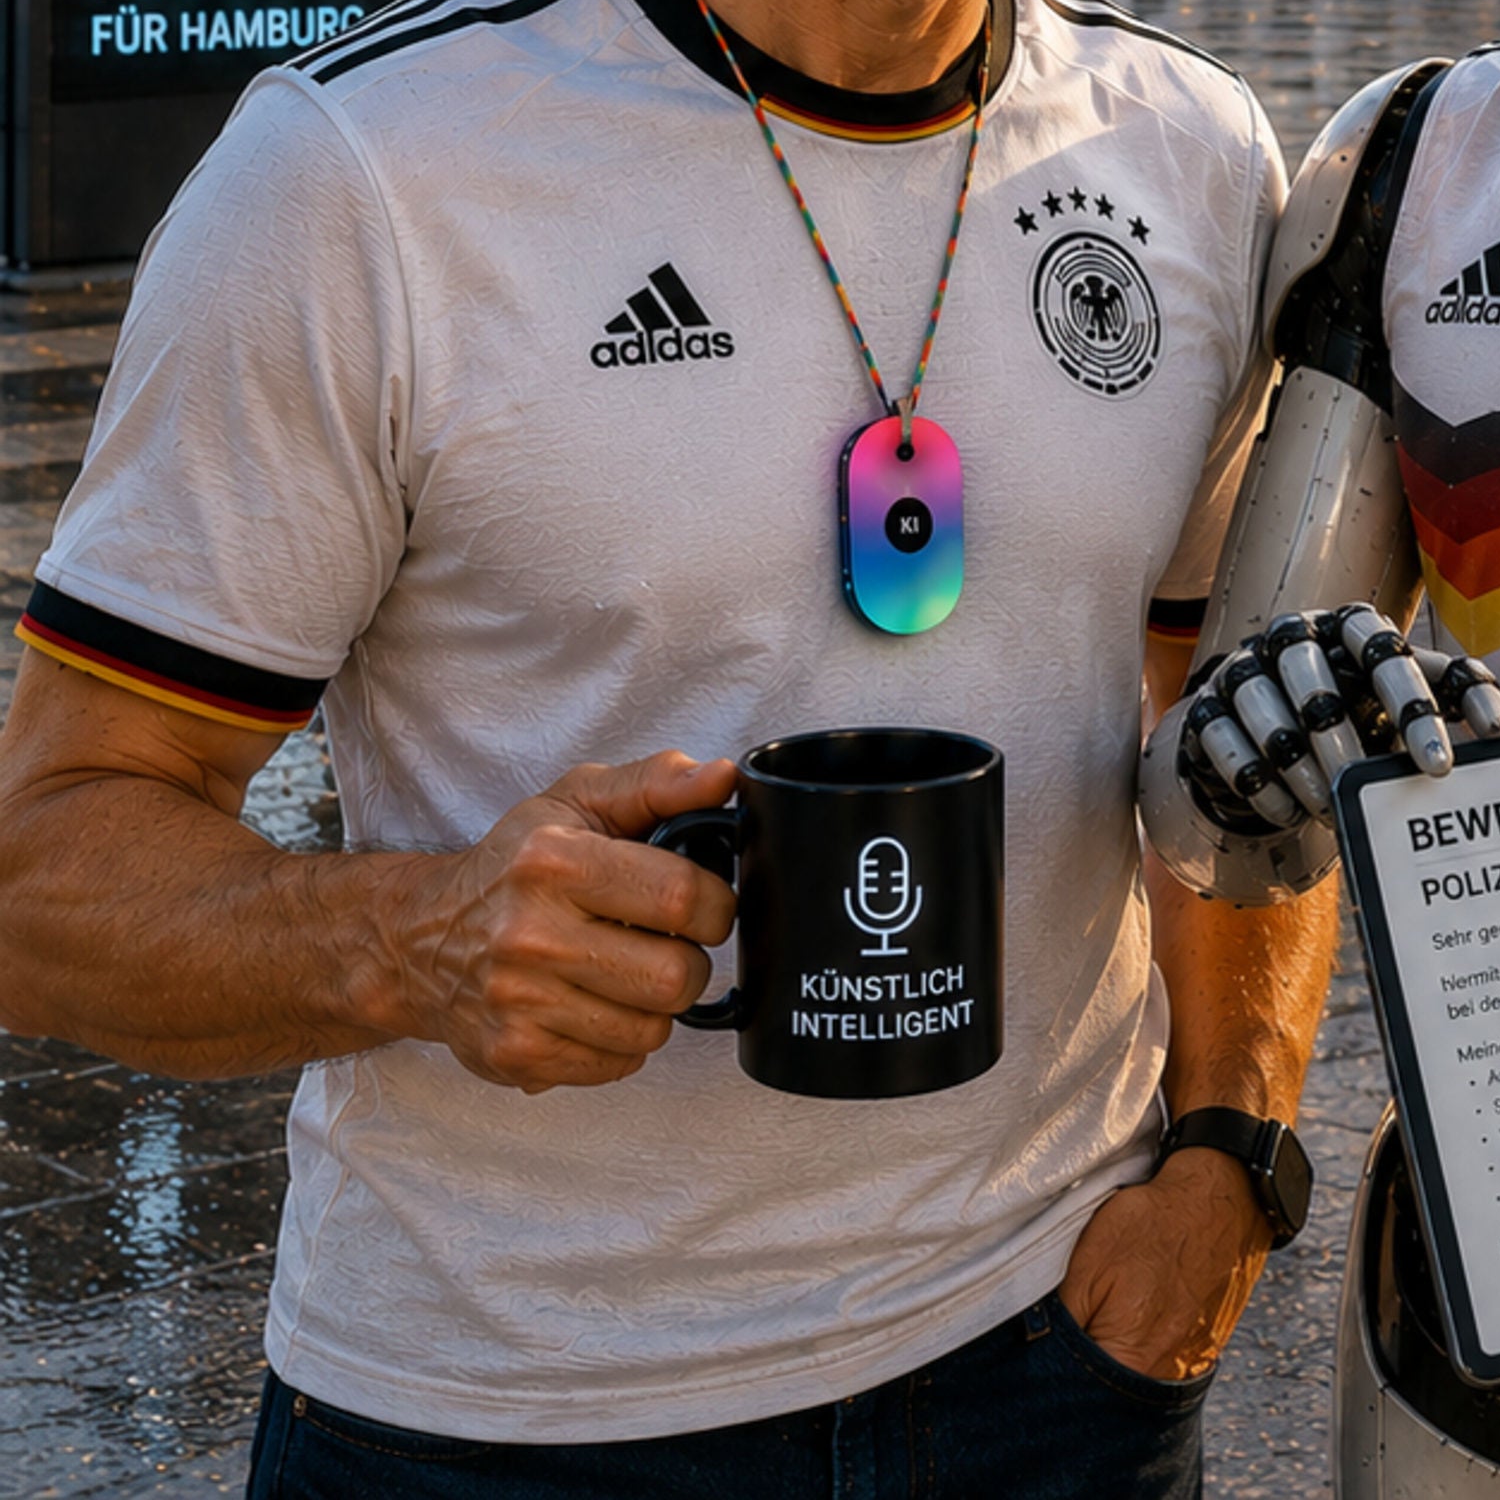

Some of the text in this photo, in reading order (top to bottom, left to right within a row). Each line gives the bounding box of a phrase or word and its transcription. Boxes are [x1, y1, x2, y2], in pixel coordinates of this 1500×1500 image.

[93, 5, 167, 55] FÜR
[590, 326, 735, 369] adidas
[900, 516, 920, 534] KI
[1431, 929, 1474, 951] Sehr
[801, 965, 963, 1000] KÜNSTLICH
[792, 999, 974, 1040] INTELLIGENT
[1446, 995, 1474, 1021] bei
